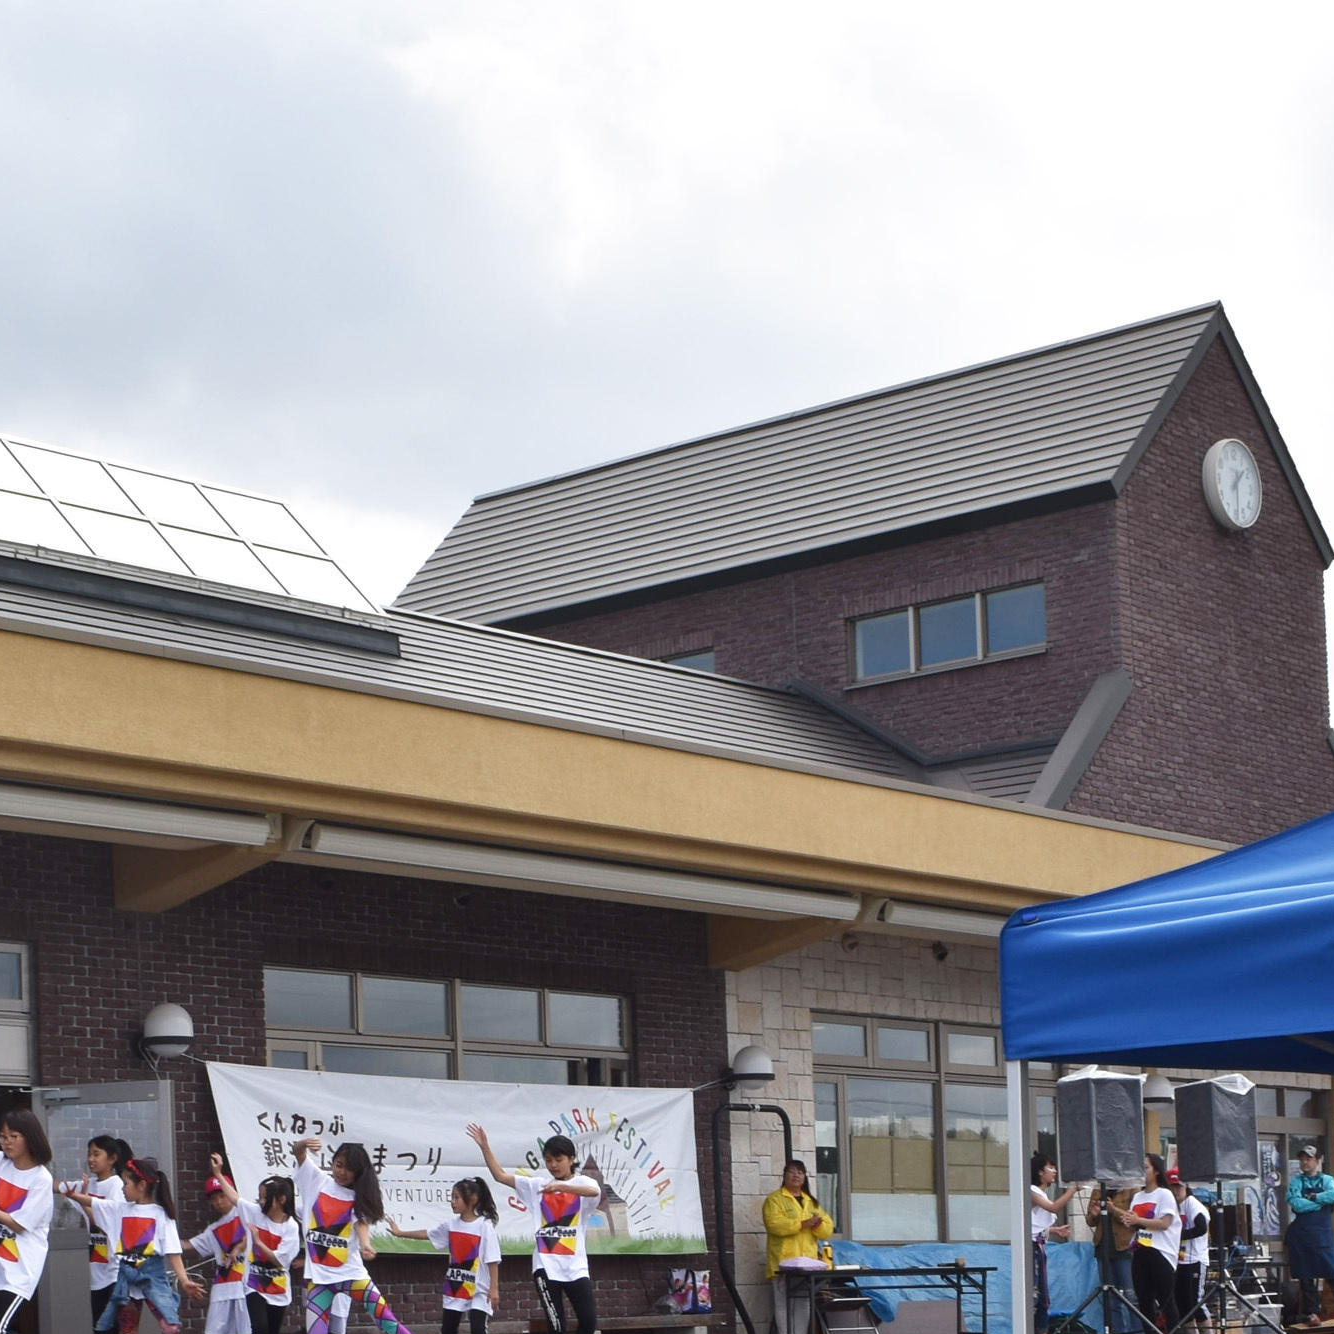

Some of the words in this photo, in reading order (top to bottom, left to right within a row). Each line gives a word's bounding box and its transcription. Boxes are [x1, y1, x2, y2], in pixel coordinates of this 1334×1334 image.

[257, 1112, 345, 1135] くんねっぷ
[548, 1107, 600, 1137] PARK
[606, 1112, 675, 1210] FESTIVAL
[385, 1188, 451, 1202] VENTURE
